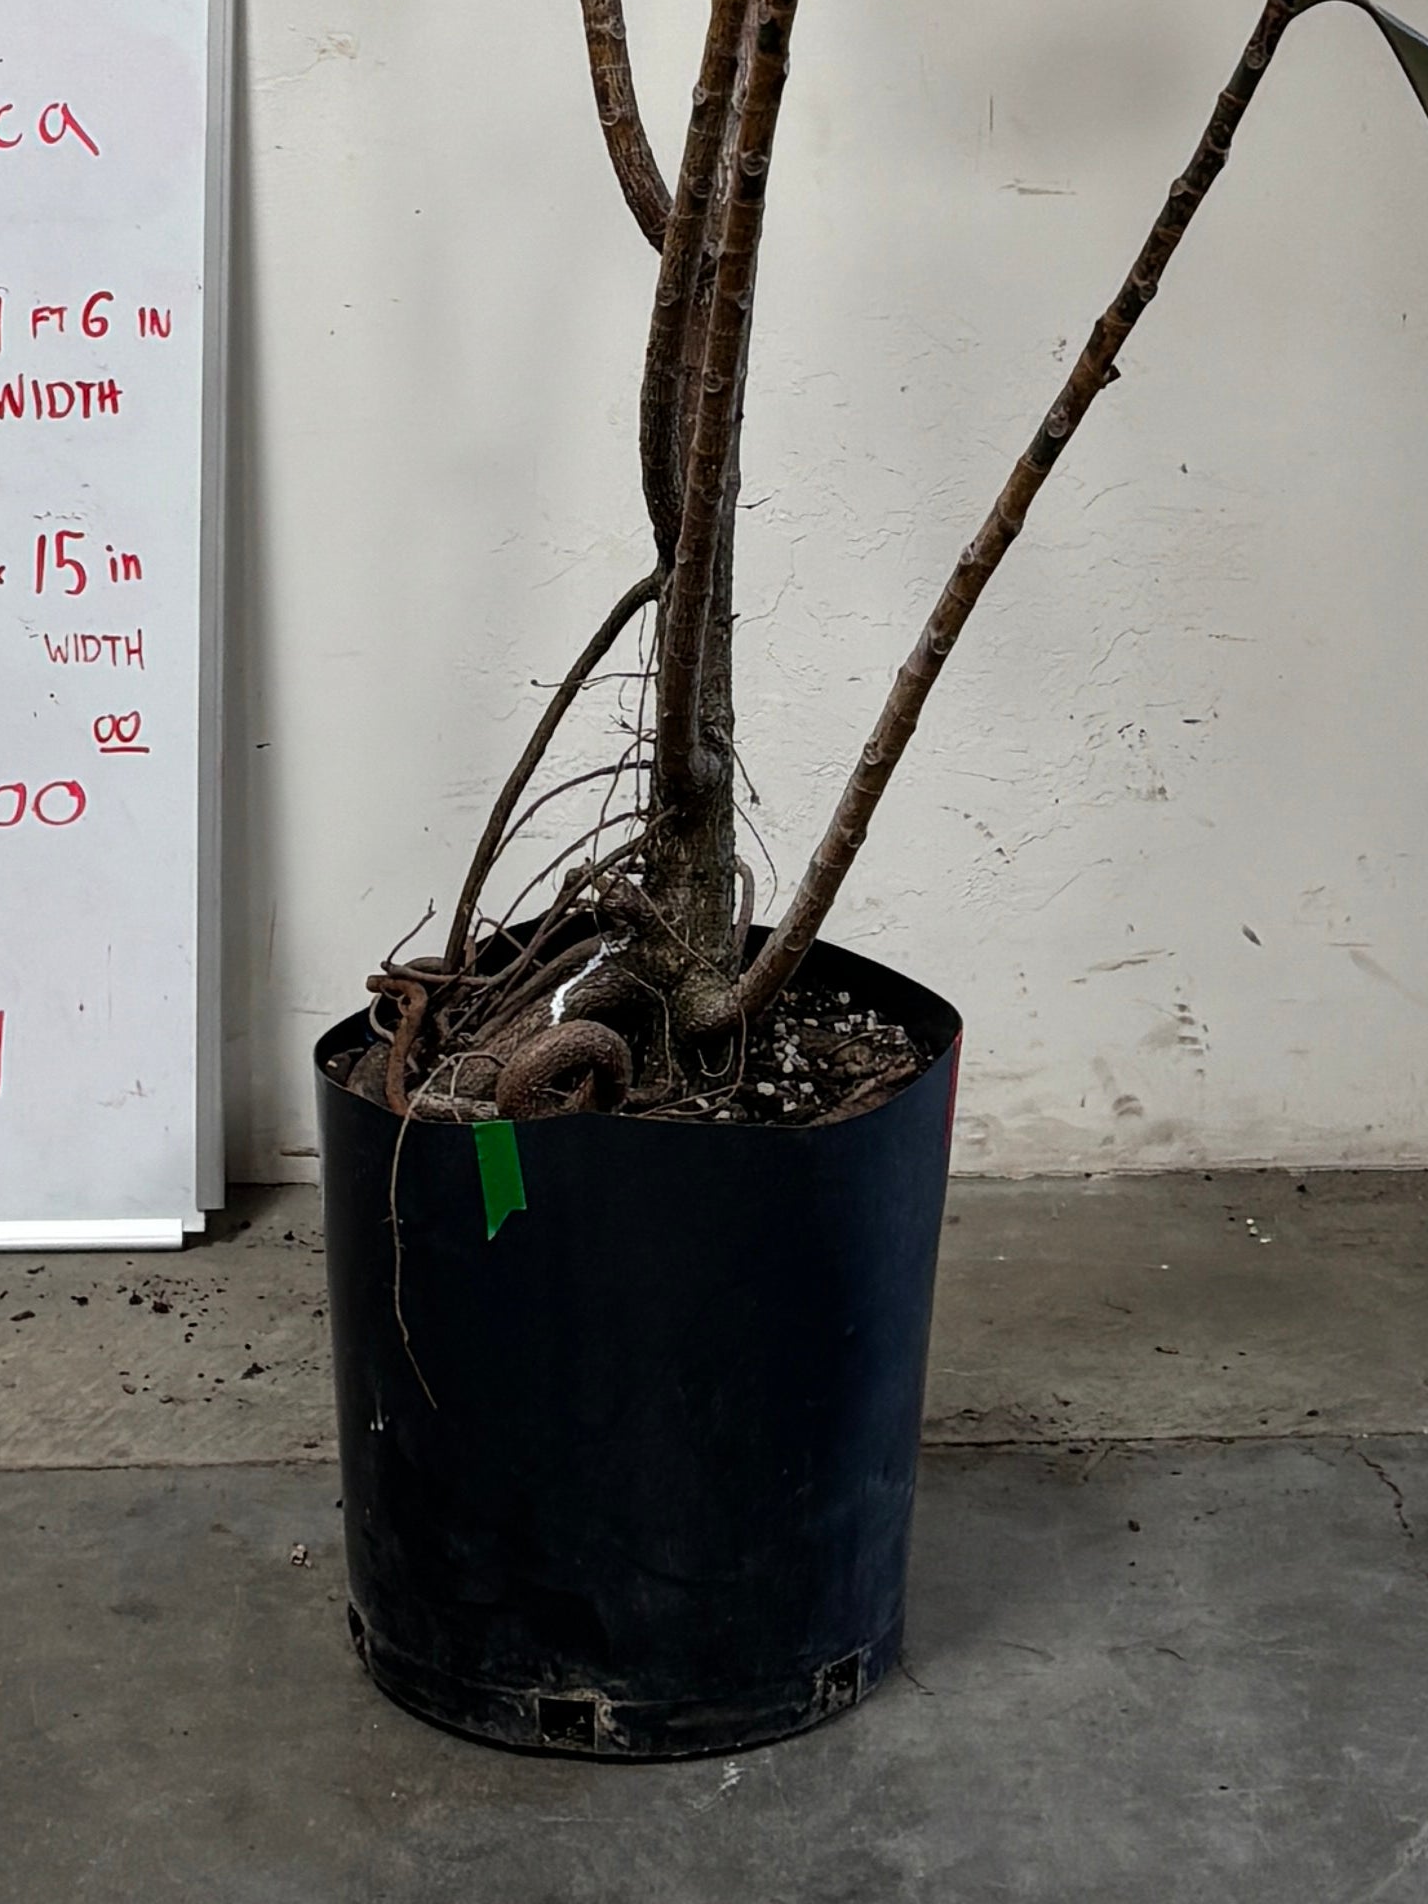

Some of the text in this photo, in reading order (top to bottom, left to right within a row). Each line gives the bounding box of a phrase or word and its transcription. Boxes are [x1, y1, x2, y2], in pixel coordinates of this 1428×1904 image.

[30, 305, 66, 338] FT
[80, 289, 115, 340] 6
[137, 306, 173, 340] IN
[34, 529, 89, 596] 15
[106, 543, 144, 585] in
[42, 627, 146, 671] WIDTH
